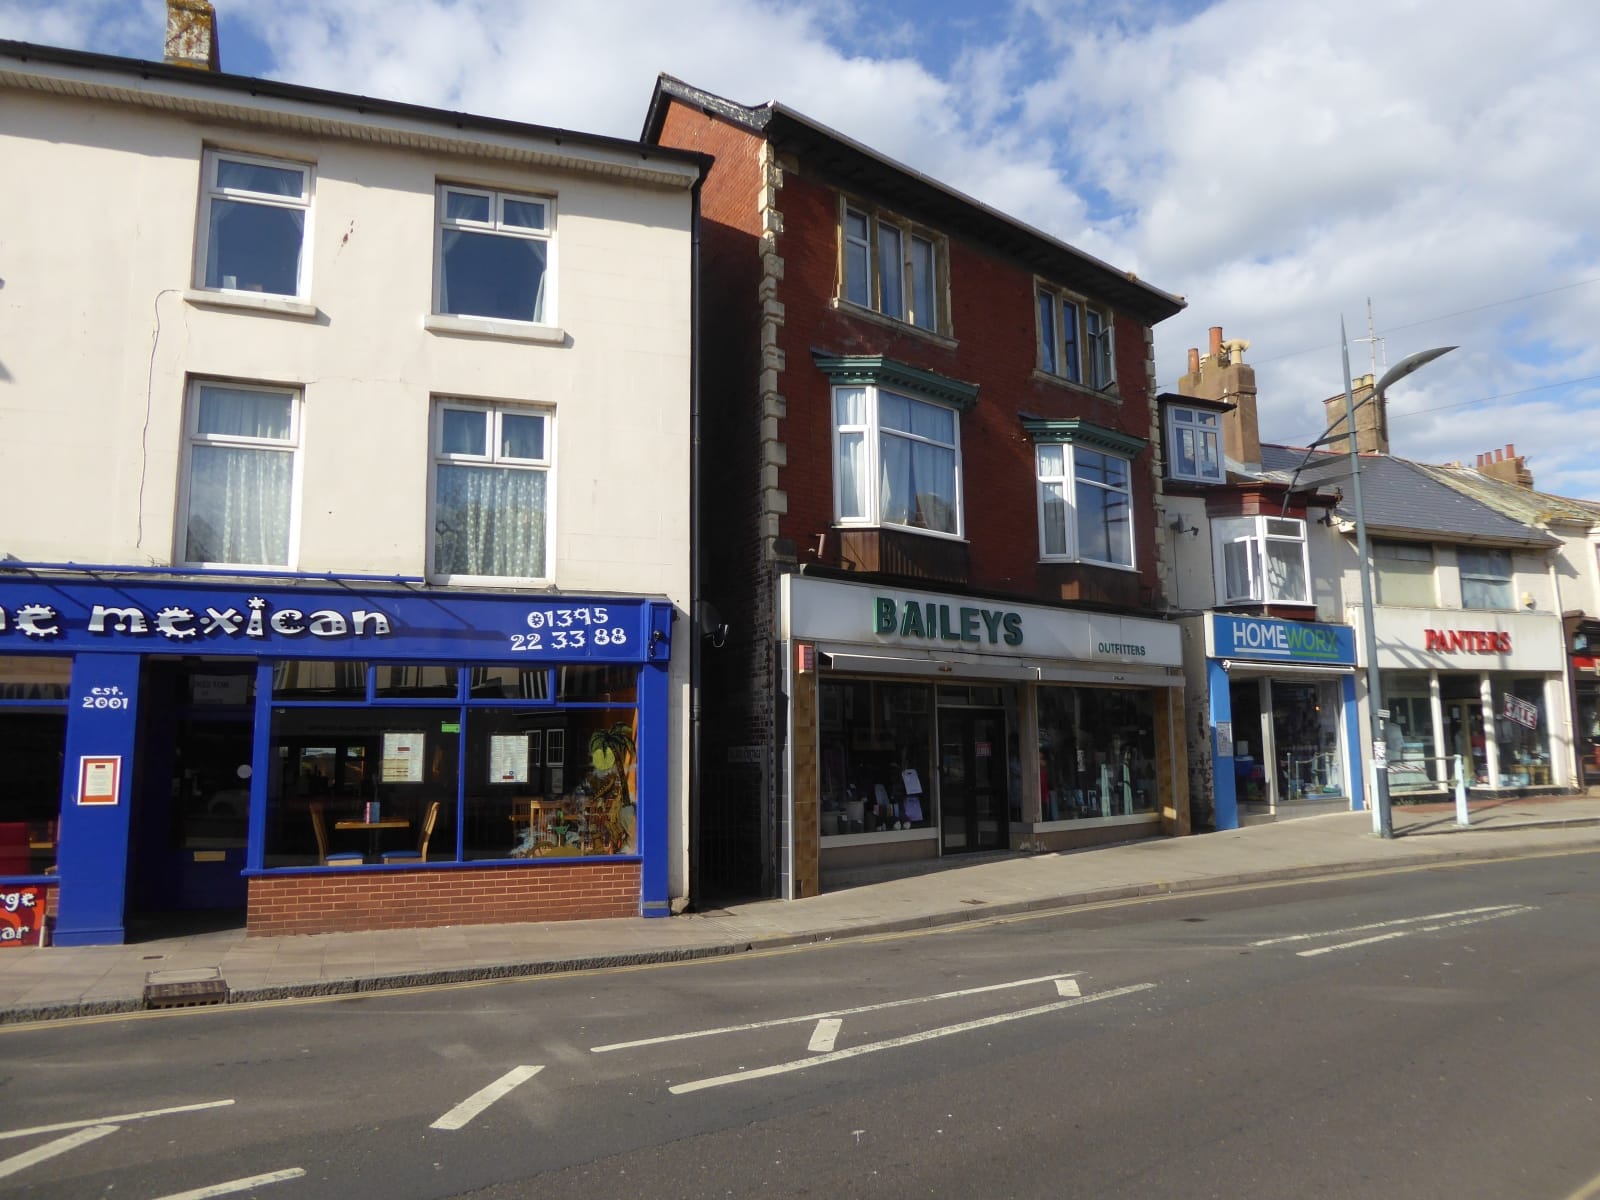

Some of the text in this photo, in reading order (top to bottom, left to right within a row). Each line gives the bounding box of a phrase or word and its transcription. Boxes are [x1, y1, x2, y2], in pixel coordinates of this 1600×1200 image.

[87, 596, 391, 639] mexican
[527, 607, 609, 628] 01395
[873, 597, 1024, 646] BAILEYS
[510, 627, 627, 651] 22 33 88
[1233, 621, 1339, 652] HOMEWORX
[1424, 629, 1512, 652] PANTERS
[1098, 642, 1146, 656] OUTFITTERS
[82, 696, 129, 709] 2001
[91, 686, 124, 696] est.
[1505, 702, 1535, 728] SALE
